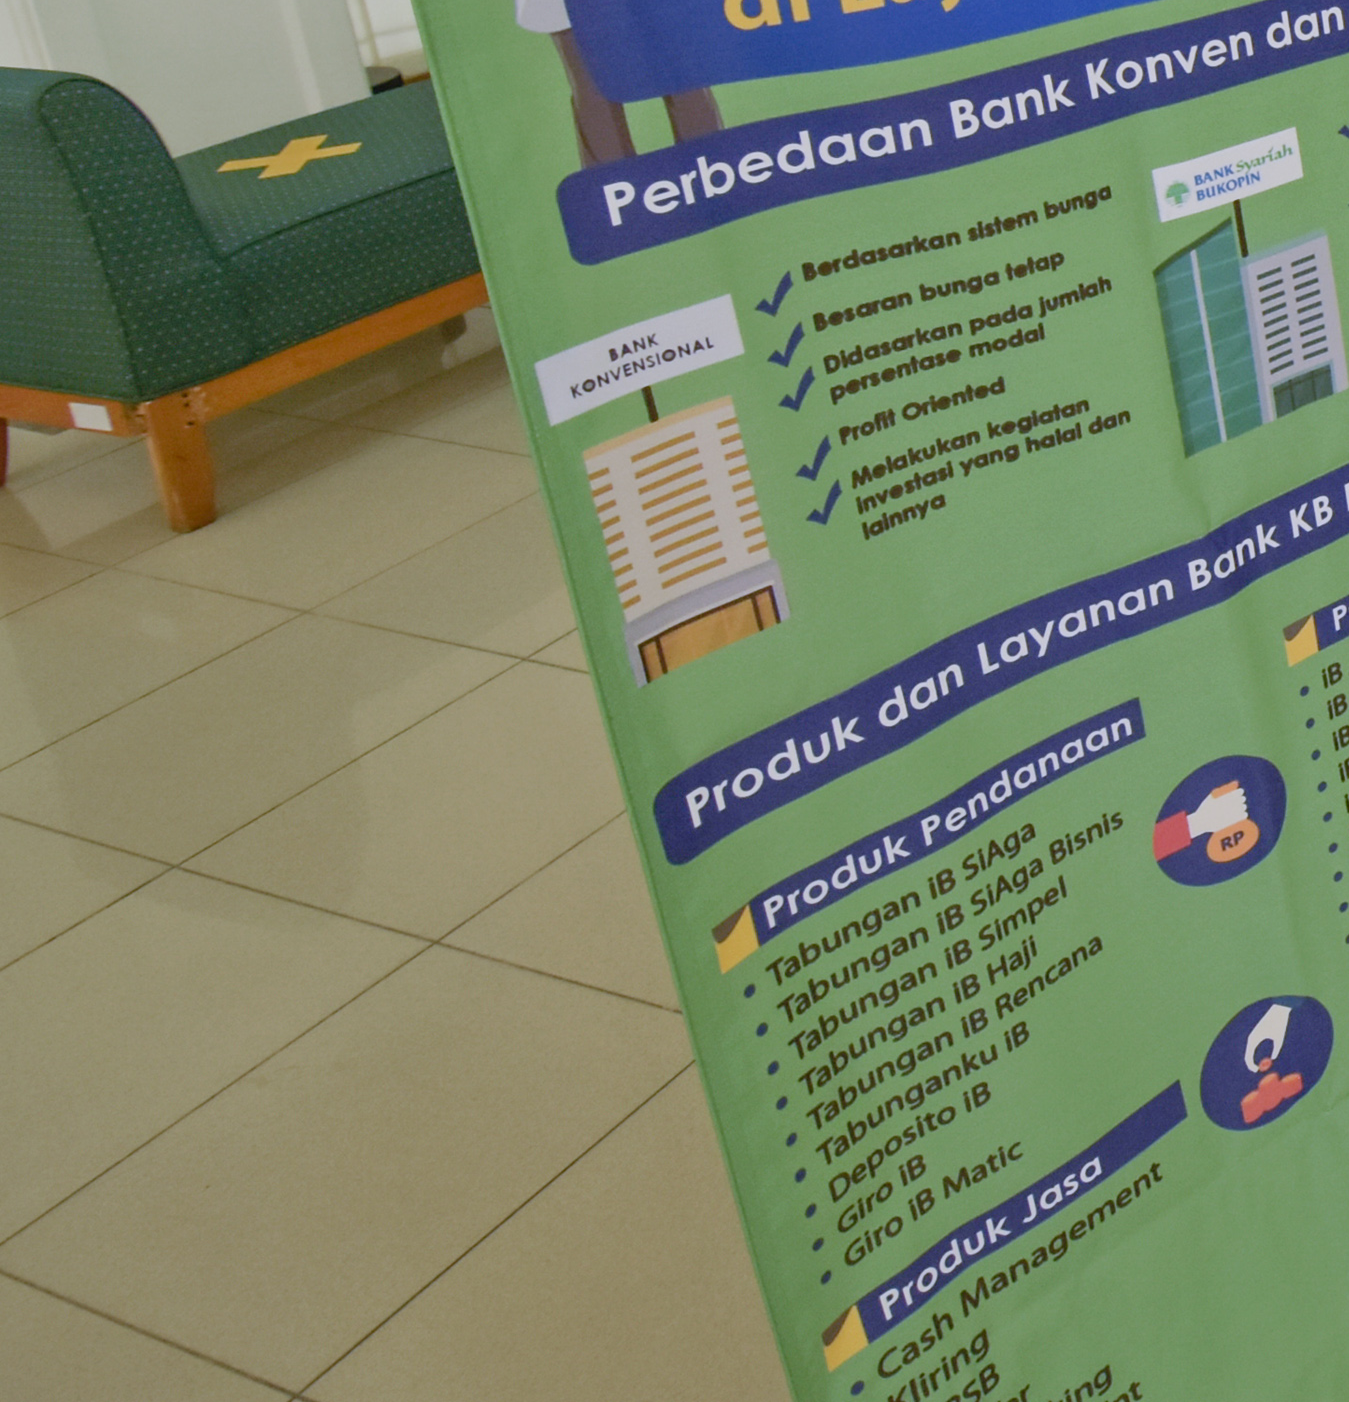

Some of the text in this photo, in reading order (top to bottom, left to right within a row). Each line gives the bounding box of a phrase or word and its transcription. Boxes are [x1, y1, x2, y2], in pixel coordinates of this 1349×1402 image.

[602, 118, 933, 226] Perbedaan
[948, 73, 1075, 139] Bank
[1084, 30, 1254, 100] Konven
[1265, 5, 1344, 49] dan
[1193, 143, 1293, 186] BANK Syariah
[800, 184, 1112, 282] Berdasarkan sistem bunga
[1195, 170, 1261, 201] BUKOPIN
[811, 251, 1065, 332] Besaran bunga tetap
[822, 275, 1112, 374] Didasarkan pada jumlah
[569, 336, 714, 398] KONVENSIONAL
[607, 333, 658, 362] BANK
[829, 321, 1045, 406] persentase modal
[837, 375, 1006, 446] Profit Oriented
[850, 398, 1090, 489] Melakukan kegiatan
[855, 409, 1131, 515] investasi yang halal dan
[860, 493, 946, 540] lainnya
[685, 715, 865, 828] Produk
[877, 663, 964, 727] dan
[976, 578, 1174, 675] Layanan
[1187, 523, 1280, 591] Bank
[1288, 494, 1333, 538] KB
[1321, 661, 1343, 689] iB
[1326, 692, 1348, 720] iB
[763, 718, 1131, 927] Produk Pendanaan
[1219, 830, 1245, 852] RP
[764, 822, 1036, 986] Tabungan iB SiAga
[786, 875, 1068, 1060] Tabungan iB Simpel
[805, 935, 1103, 1130] Tabungan iB Rencana
[827, 1081, 991, 1203] Deposito iB
[843, 1141, 1023, 1266] Giro iB Matic
[879, 1156, 1102, 1320] Produk Jasa
[876, 1162, 1163, 1378] Cash Management
